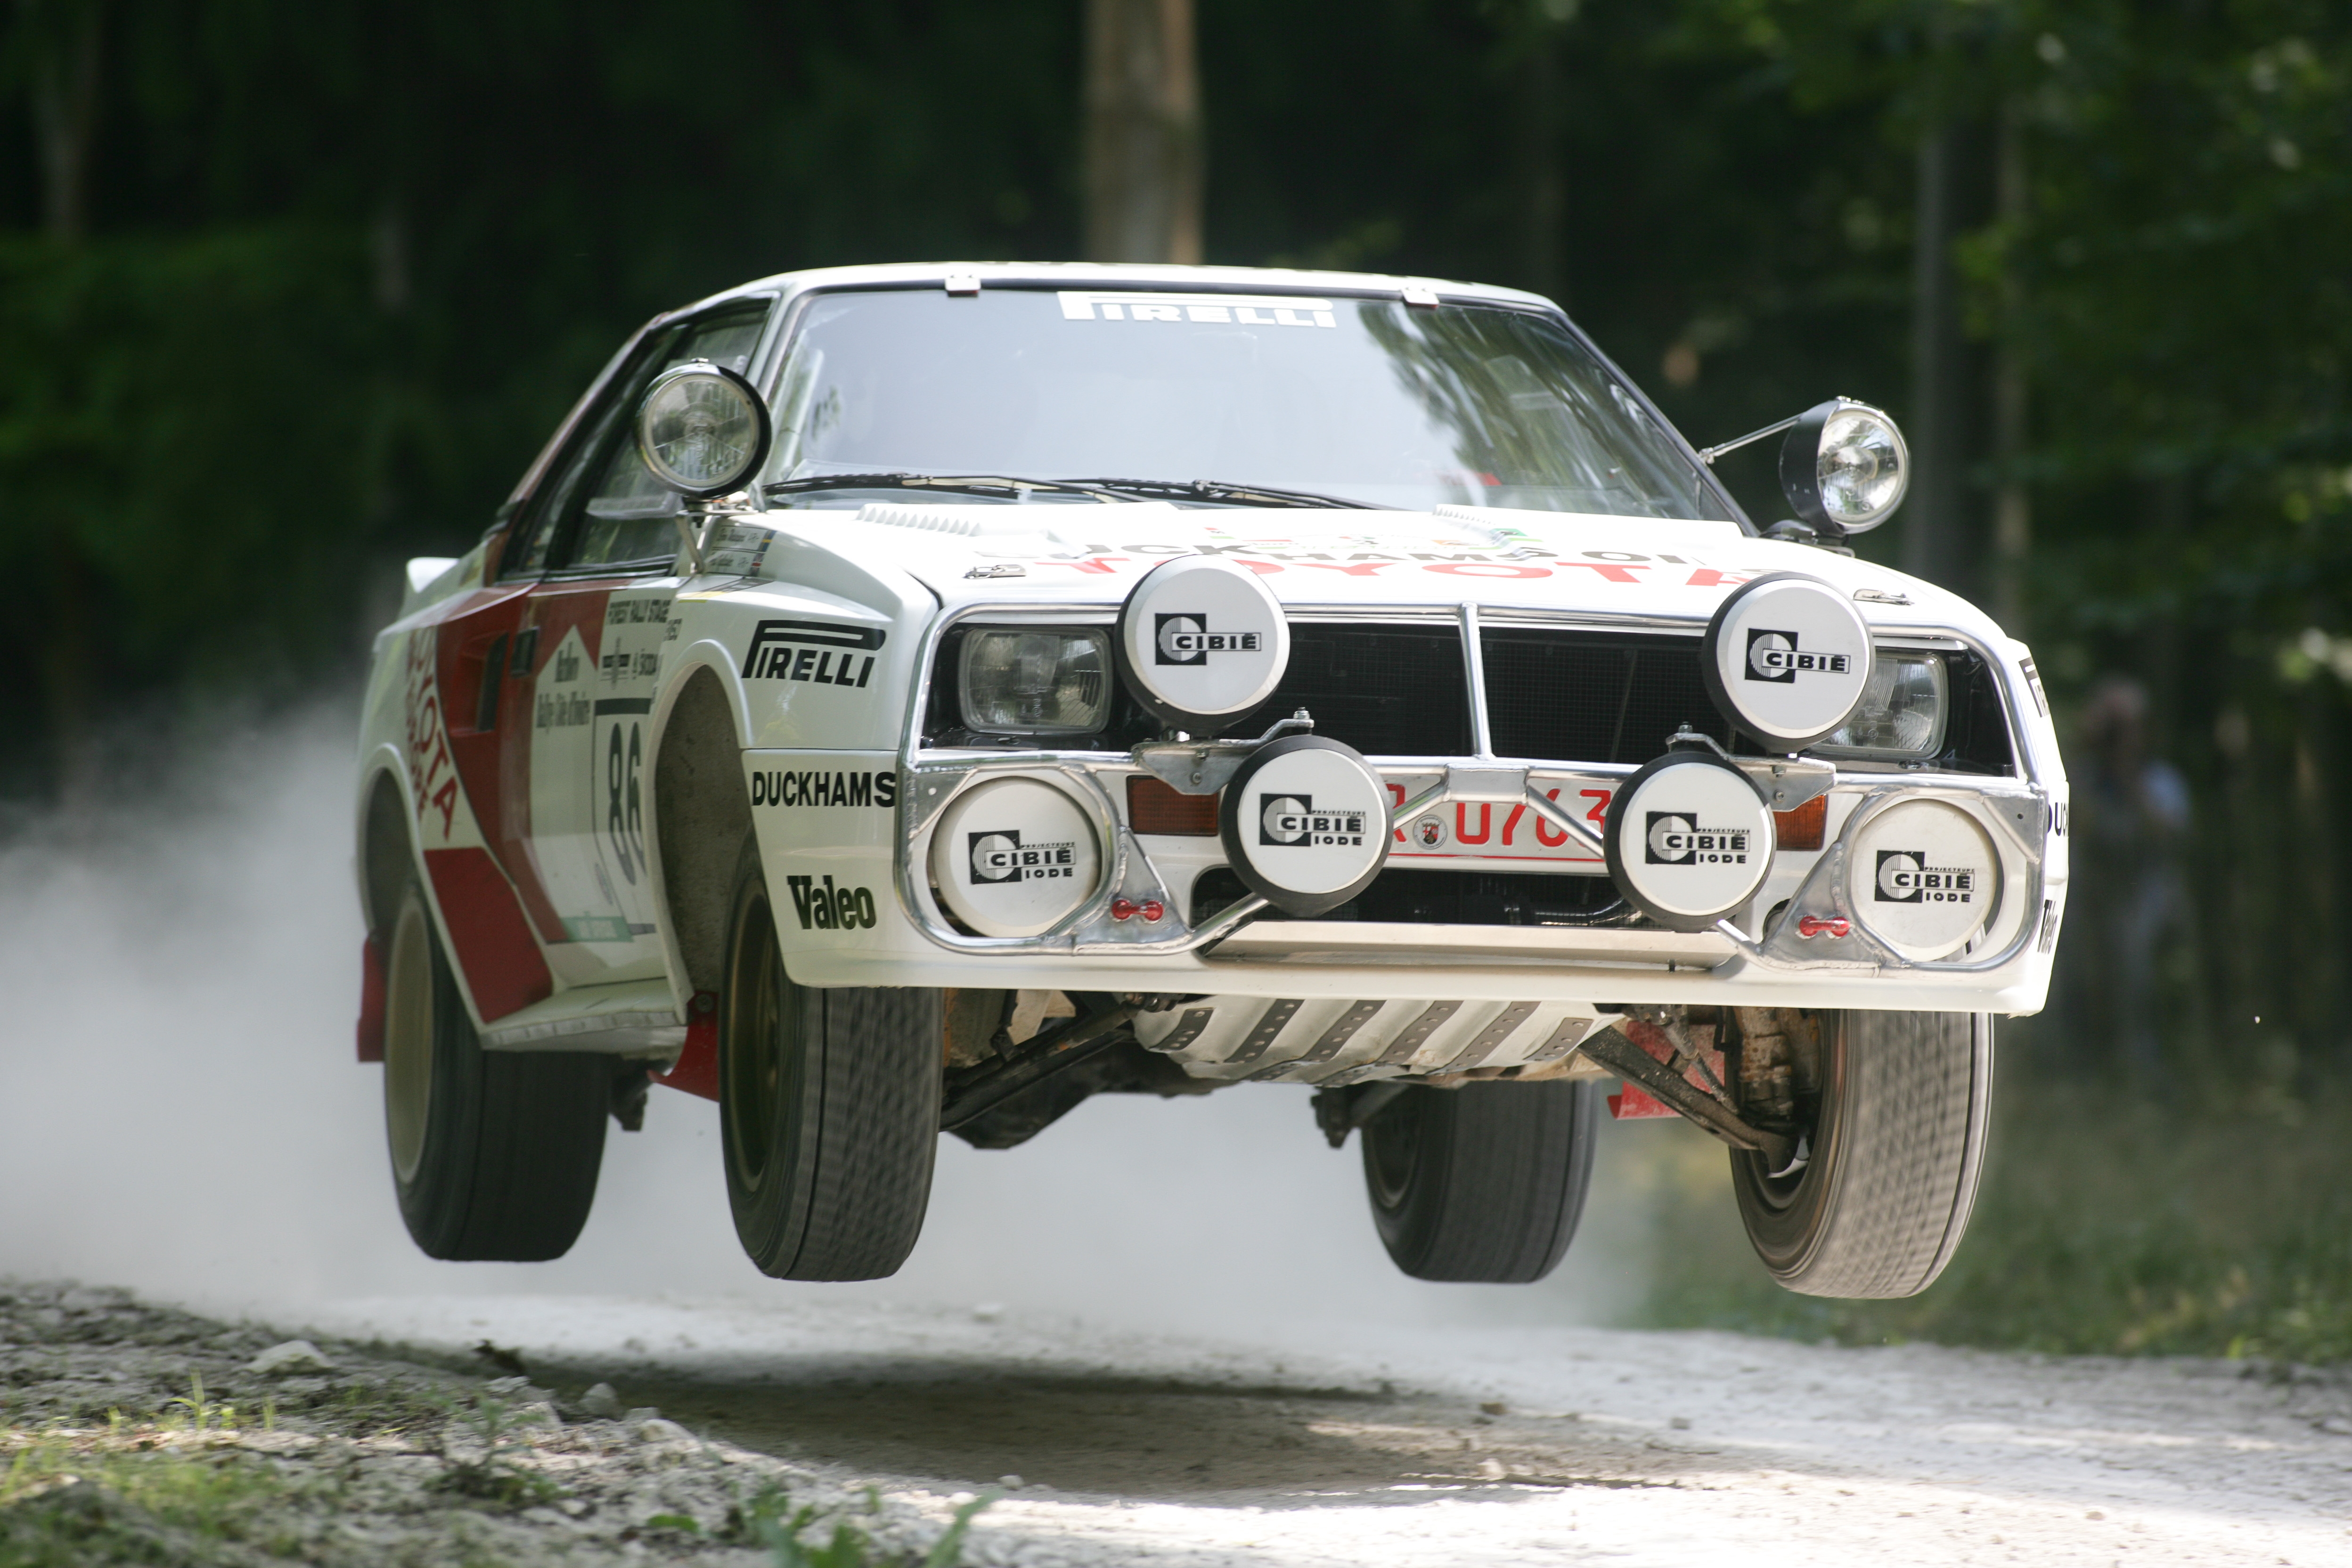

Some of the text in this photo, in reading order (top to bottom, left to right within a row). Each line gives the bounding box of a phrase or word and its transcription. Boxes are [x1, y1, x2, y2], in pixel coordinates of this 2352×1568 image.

[1057, 291, 1336, 327] PIRELLI
[972, 544, 1559, 561] UCKHAMS
[742, 620, 886, 687] PIRELLI
[752, 771, 896, 807] DUCKHAMS
[609, 722, 647, 886] 86
[1315, 835, 1362, 846] IODE
[1699, 854, 1747, 864] IODE
[1026, 867, 1073, 879] IODE
[787, 875, 877, 930] Valeo
[1926, 892, 1970, 903] IODE
